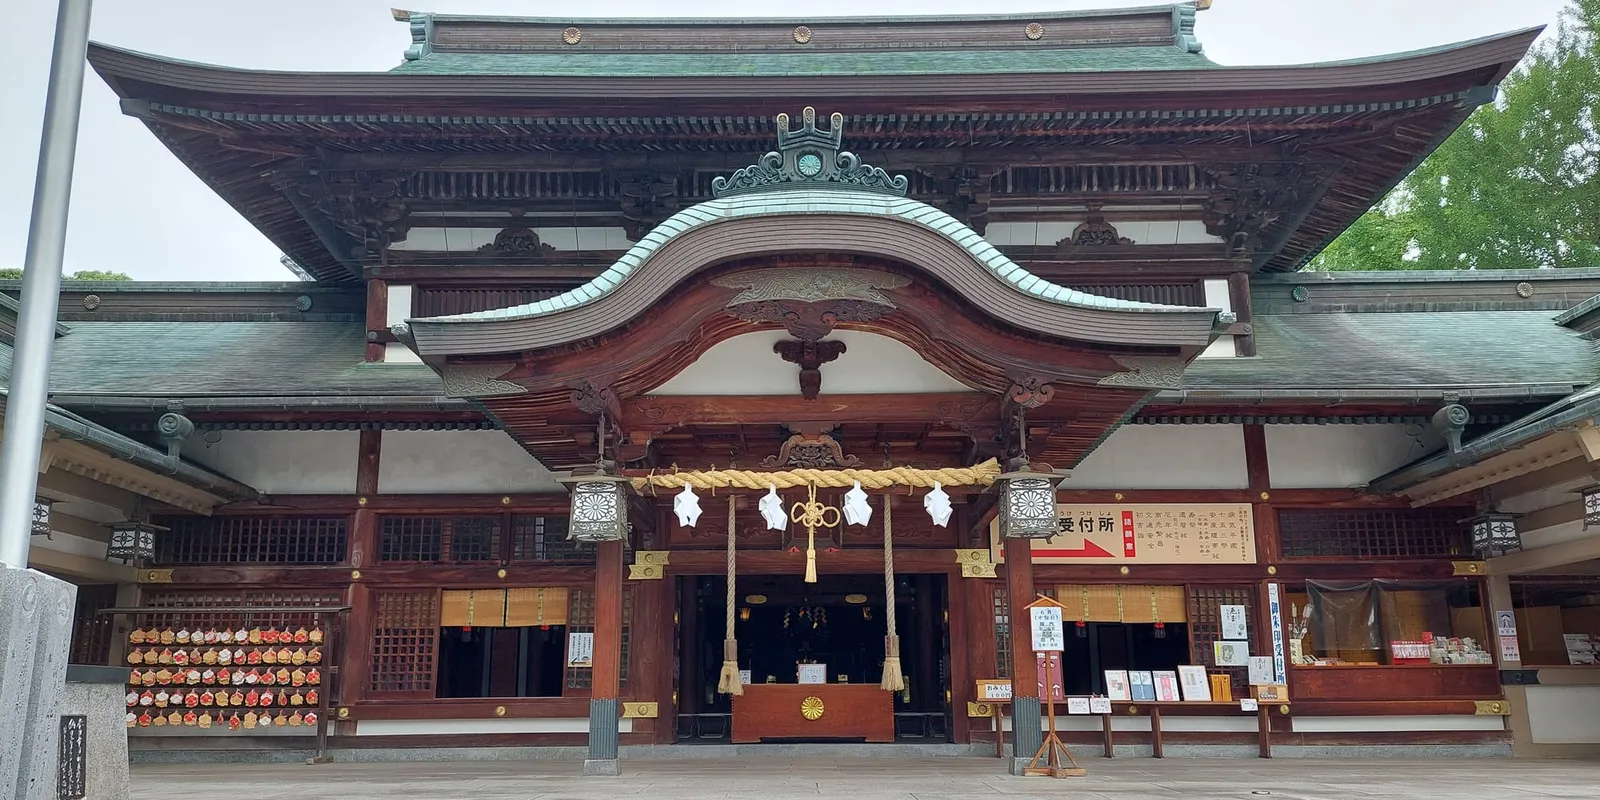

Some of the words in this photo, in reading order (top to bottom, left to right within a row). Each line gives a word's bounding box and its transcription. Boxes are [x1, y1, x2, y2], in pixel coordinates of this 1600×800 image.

[1058, 517, 1115, 533] 受付所
[1145, 511, 1155, 549] 交通安全
[1271, 602, 1285, 685] 御朱印受付所
